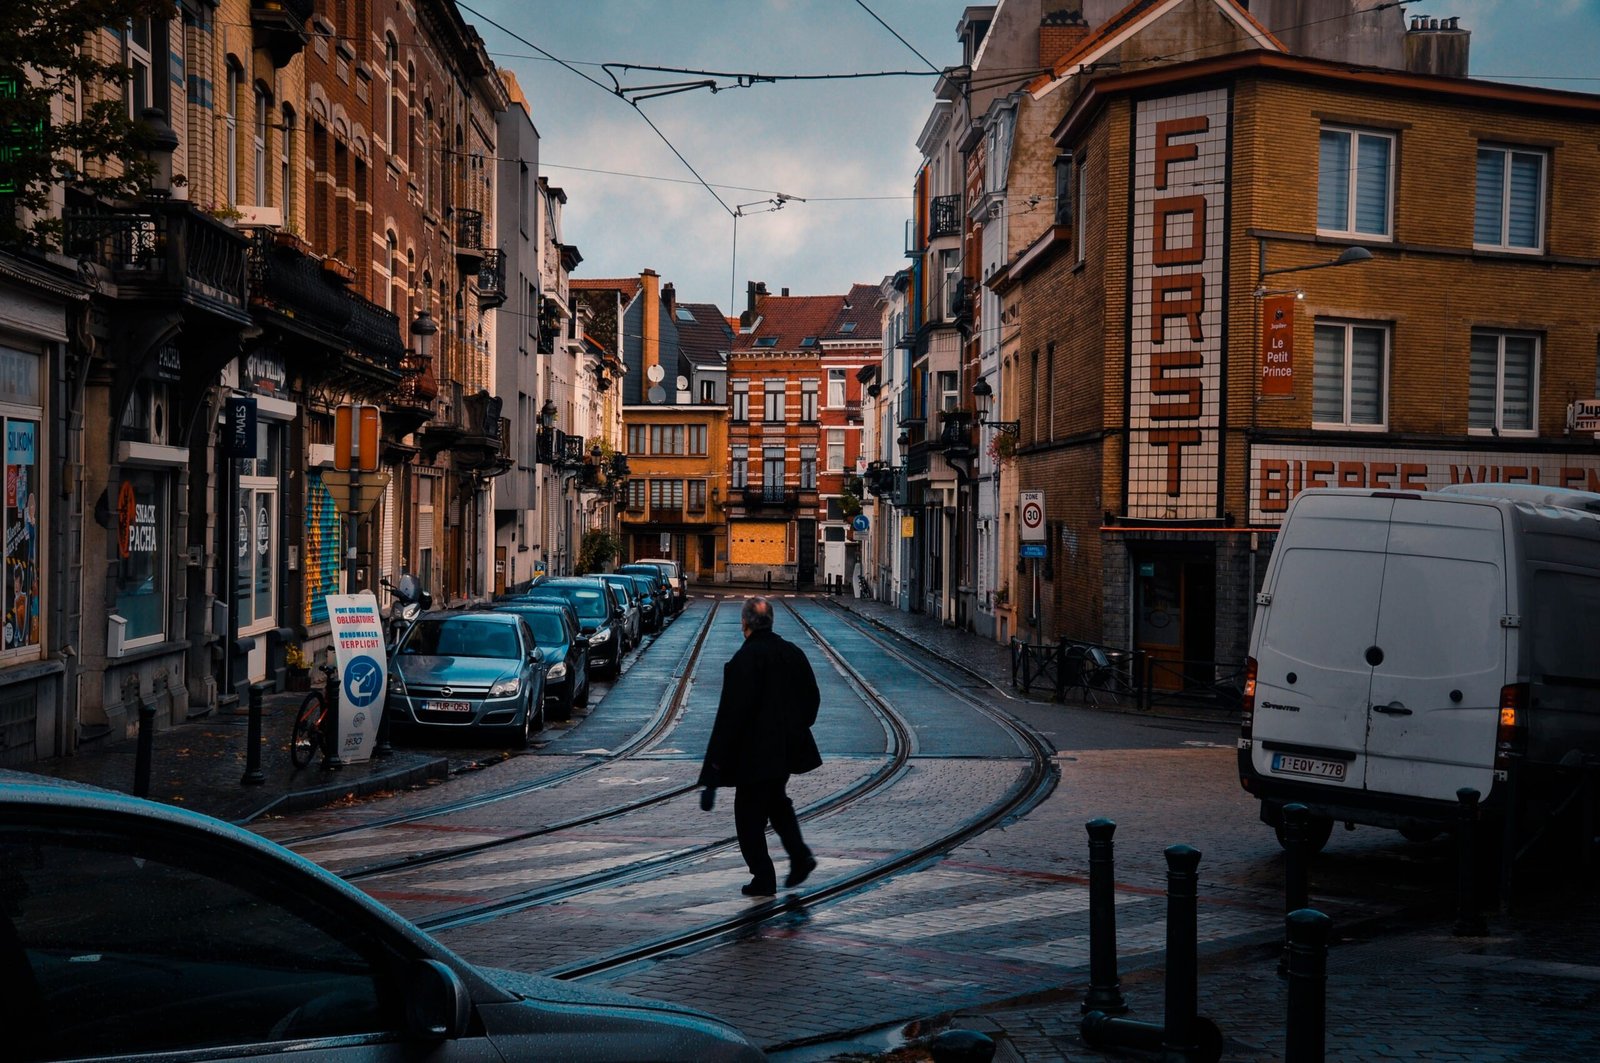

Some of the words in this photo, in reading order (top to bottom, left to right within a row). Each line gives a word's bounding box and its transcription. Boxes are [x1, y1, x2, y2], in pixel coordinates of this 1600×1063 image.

[1150, 115, 1210, 497] FORST
[1272, 337, 1284, 349] Le
[1267, 351, 1289, 363] Petit
[1263, 366, 1292, 377] Prince
[235, 405, 247, 435] MAES
[1575, 421, 1597, 429] PETIT
[136, 503, 156, 524] SNACK
[1027, 510, 1038, 521] 30
[129, 525, 157, 552] PACHA
[336, 615, 375, 624] OBLIGATOIRE
[341, 640, 379, 649] VERPLICHT
[1281, 757, 1343, 775] 1-EQV-778
